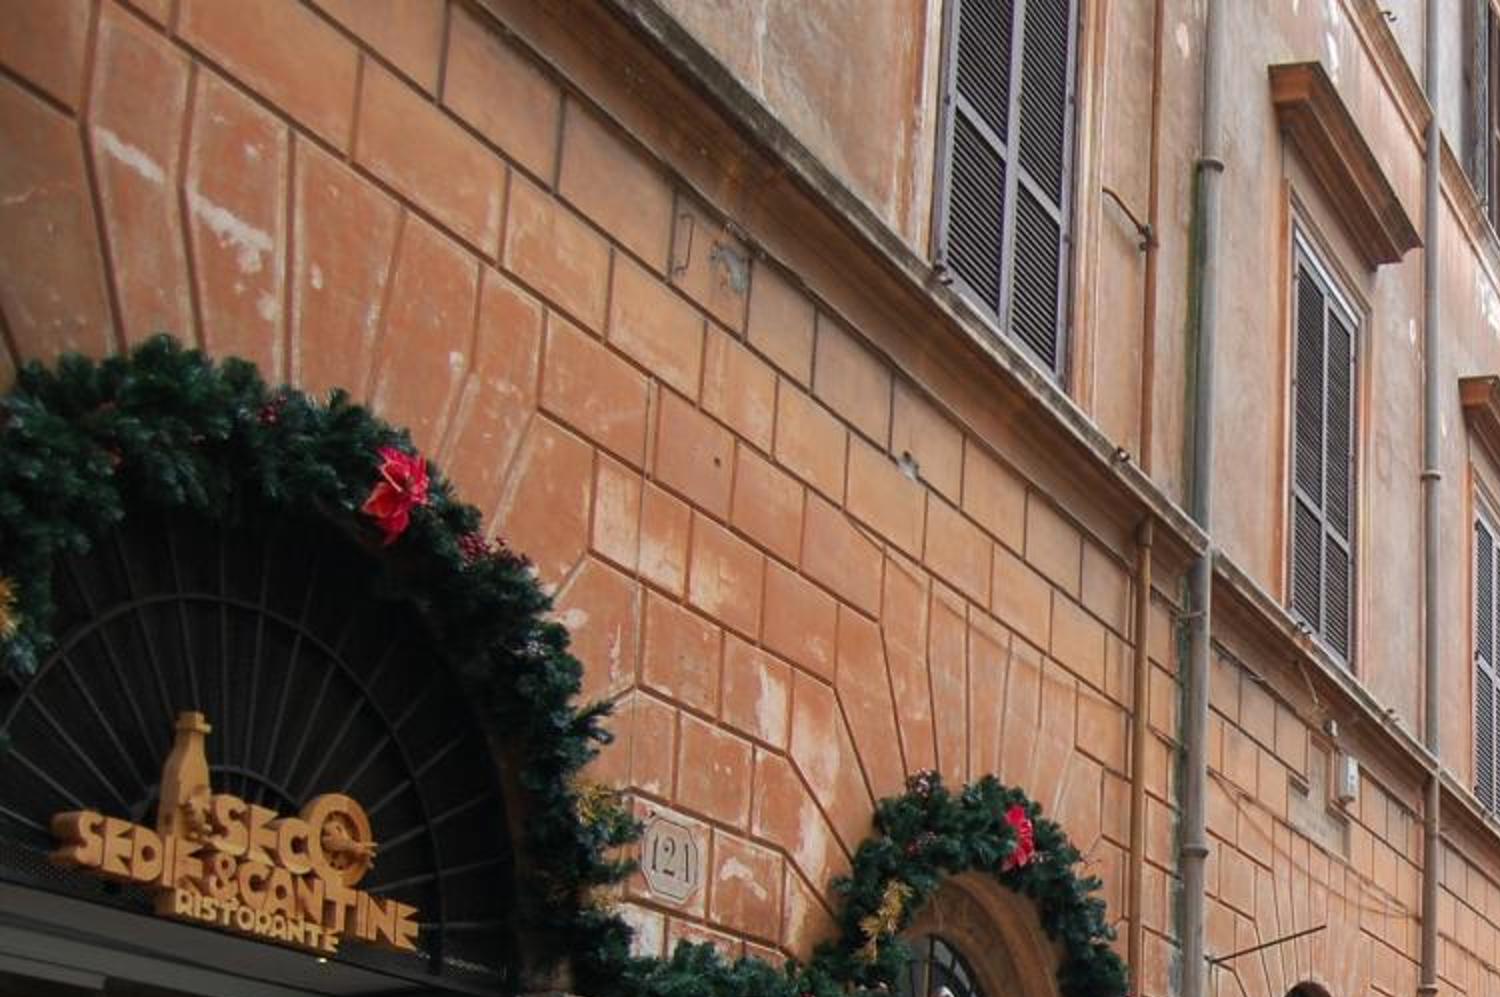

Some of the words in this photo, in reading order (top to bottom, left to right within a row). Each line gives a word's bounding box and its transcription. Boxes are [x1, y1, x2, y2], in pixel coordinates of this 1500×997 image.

[72, 809, 205, 890] SEDIE
[208, 853, 238, 900] &
[238, 860, 420, 952] CANTINE
[651, 831, 690, 884] 121
[174, 888, 340, 954] RISTORANTE
